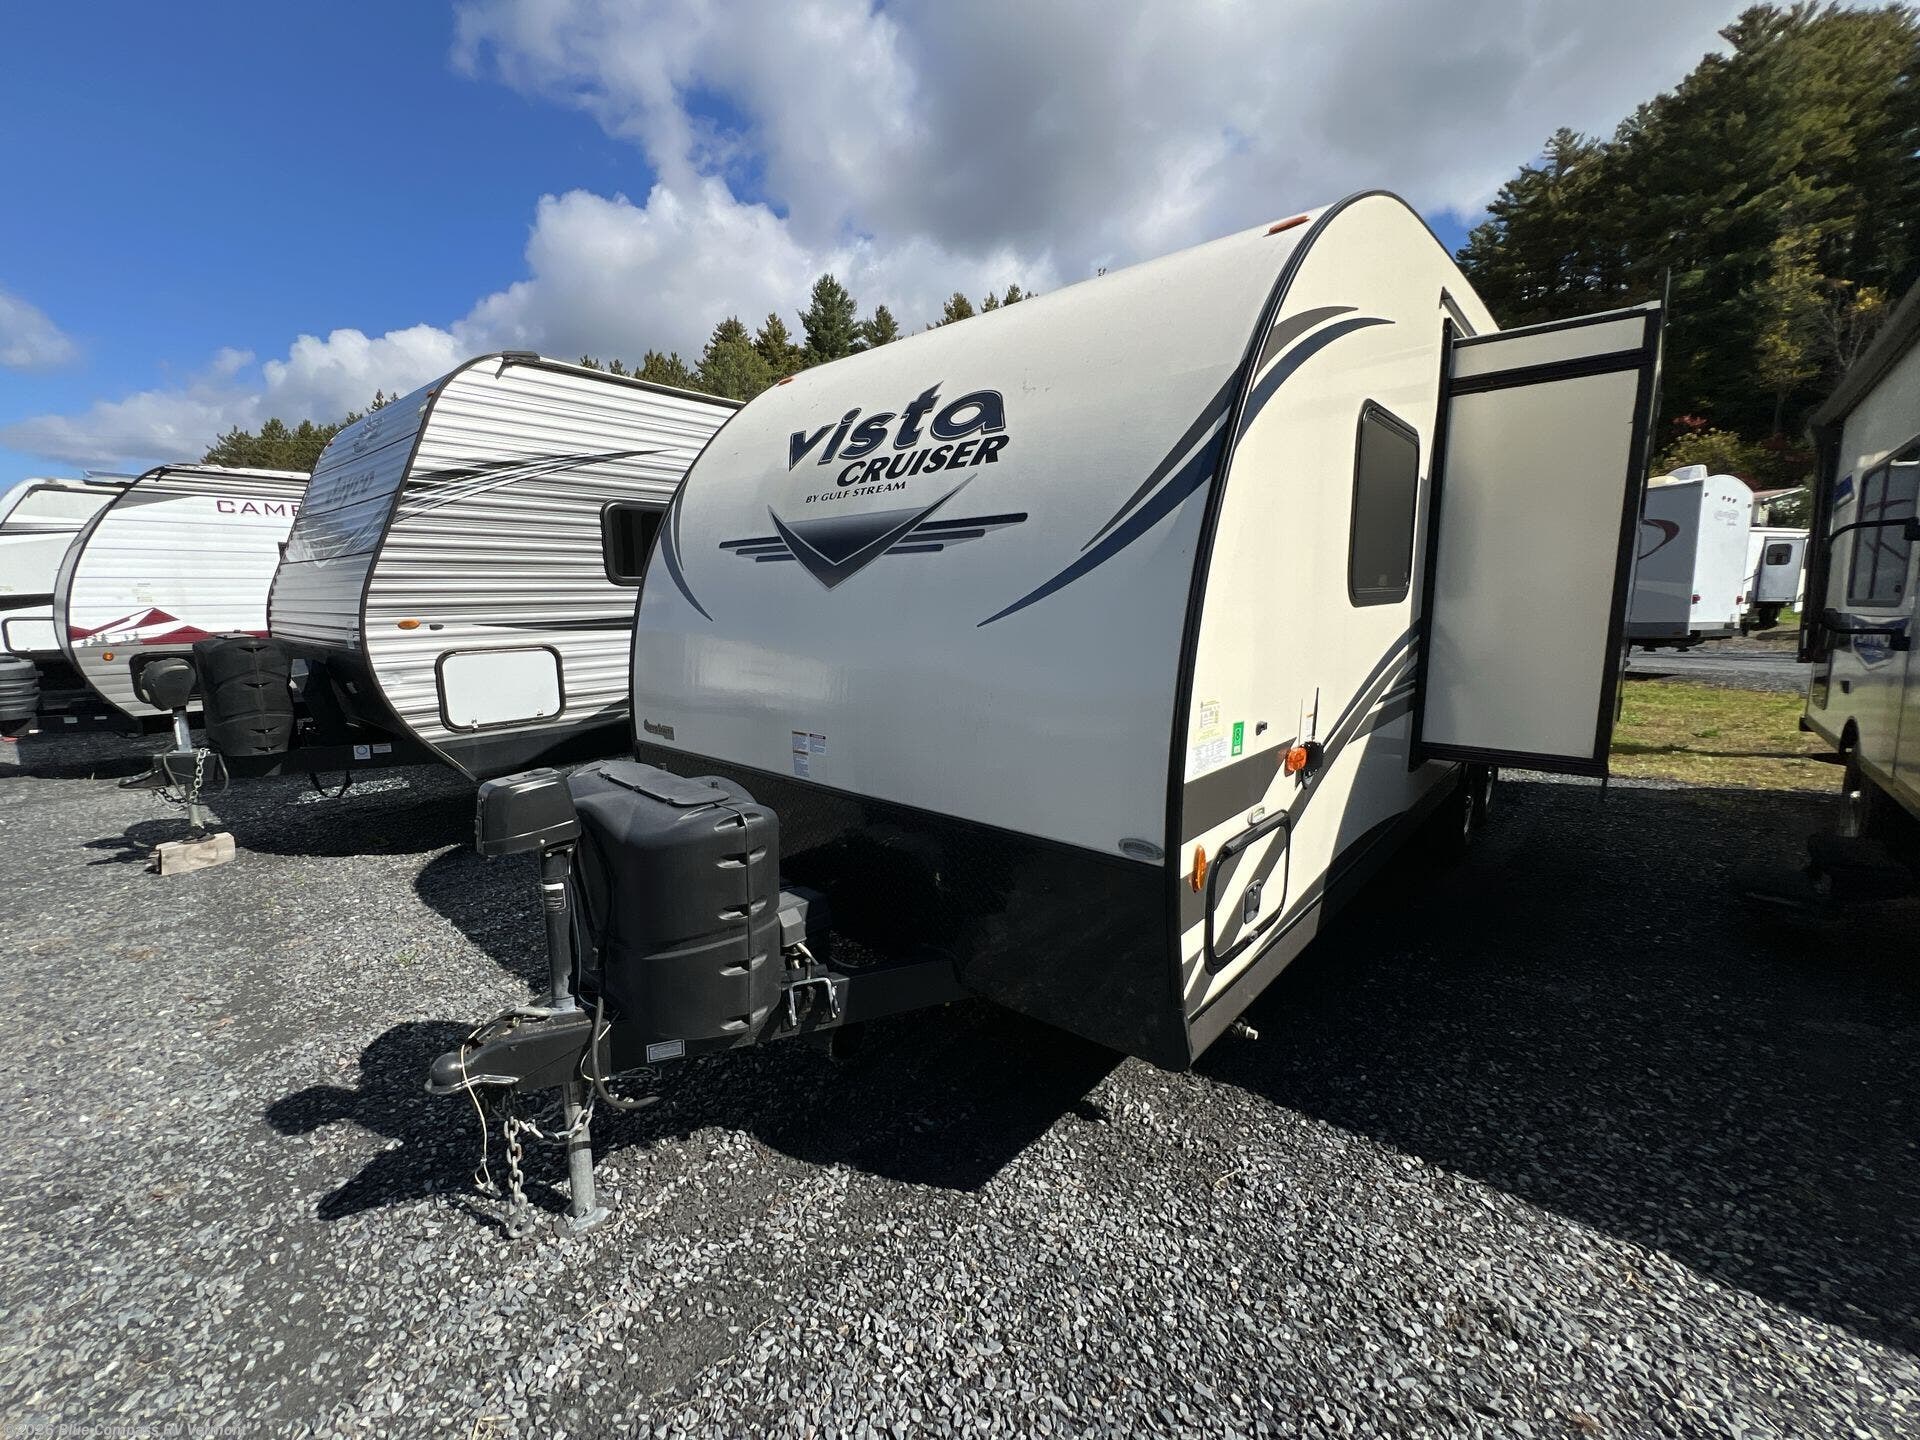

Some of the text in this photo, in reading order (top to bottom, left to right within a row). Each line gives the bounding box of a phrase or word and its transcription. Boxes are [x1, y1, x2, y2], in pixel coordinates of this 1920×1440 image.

[836, 434, 1011, 488] CRUISER
[805, 481, 907, 504] BY GULF STREAM
